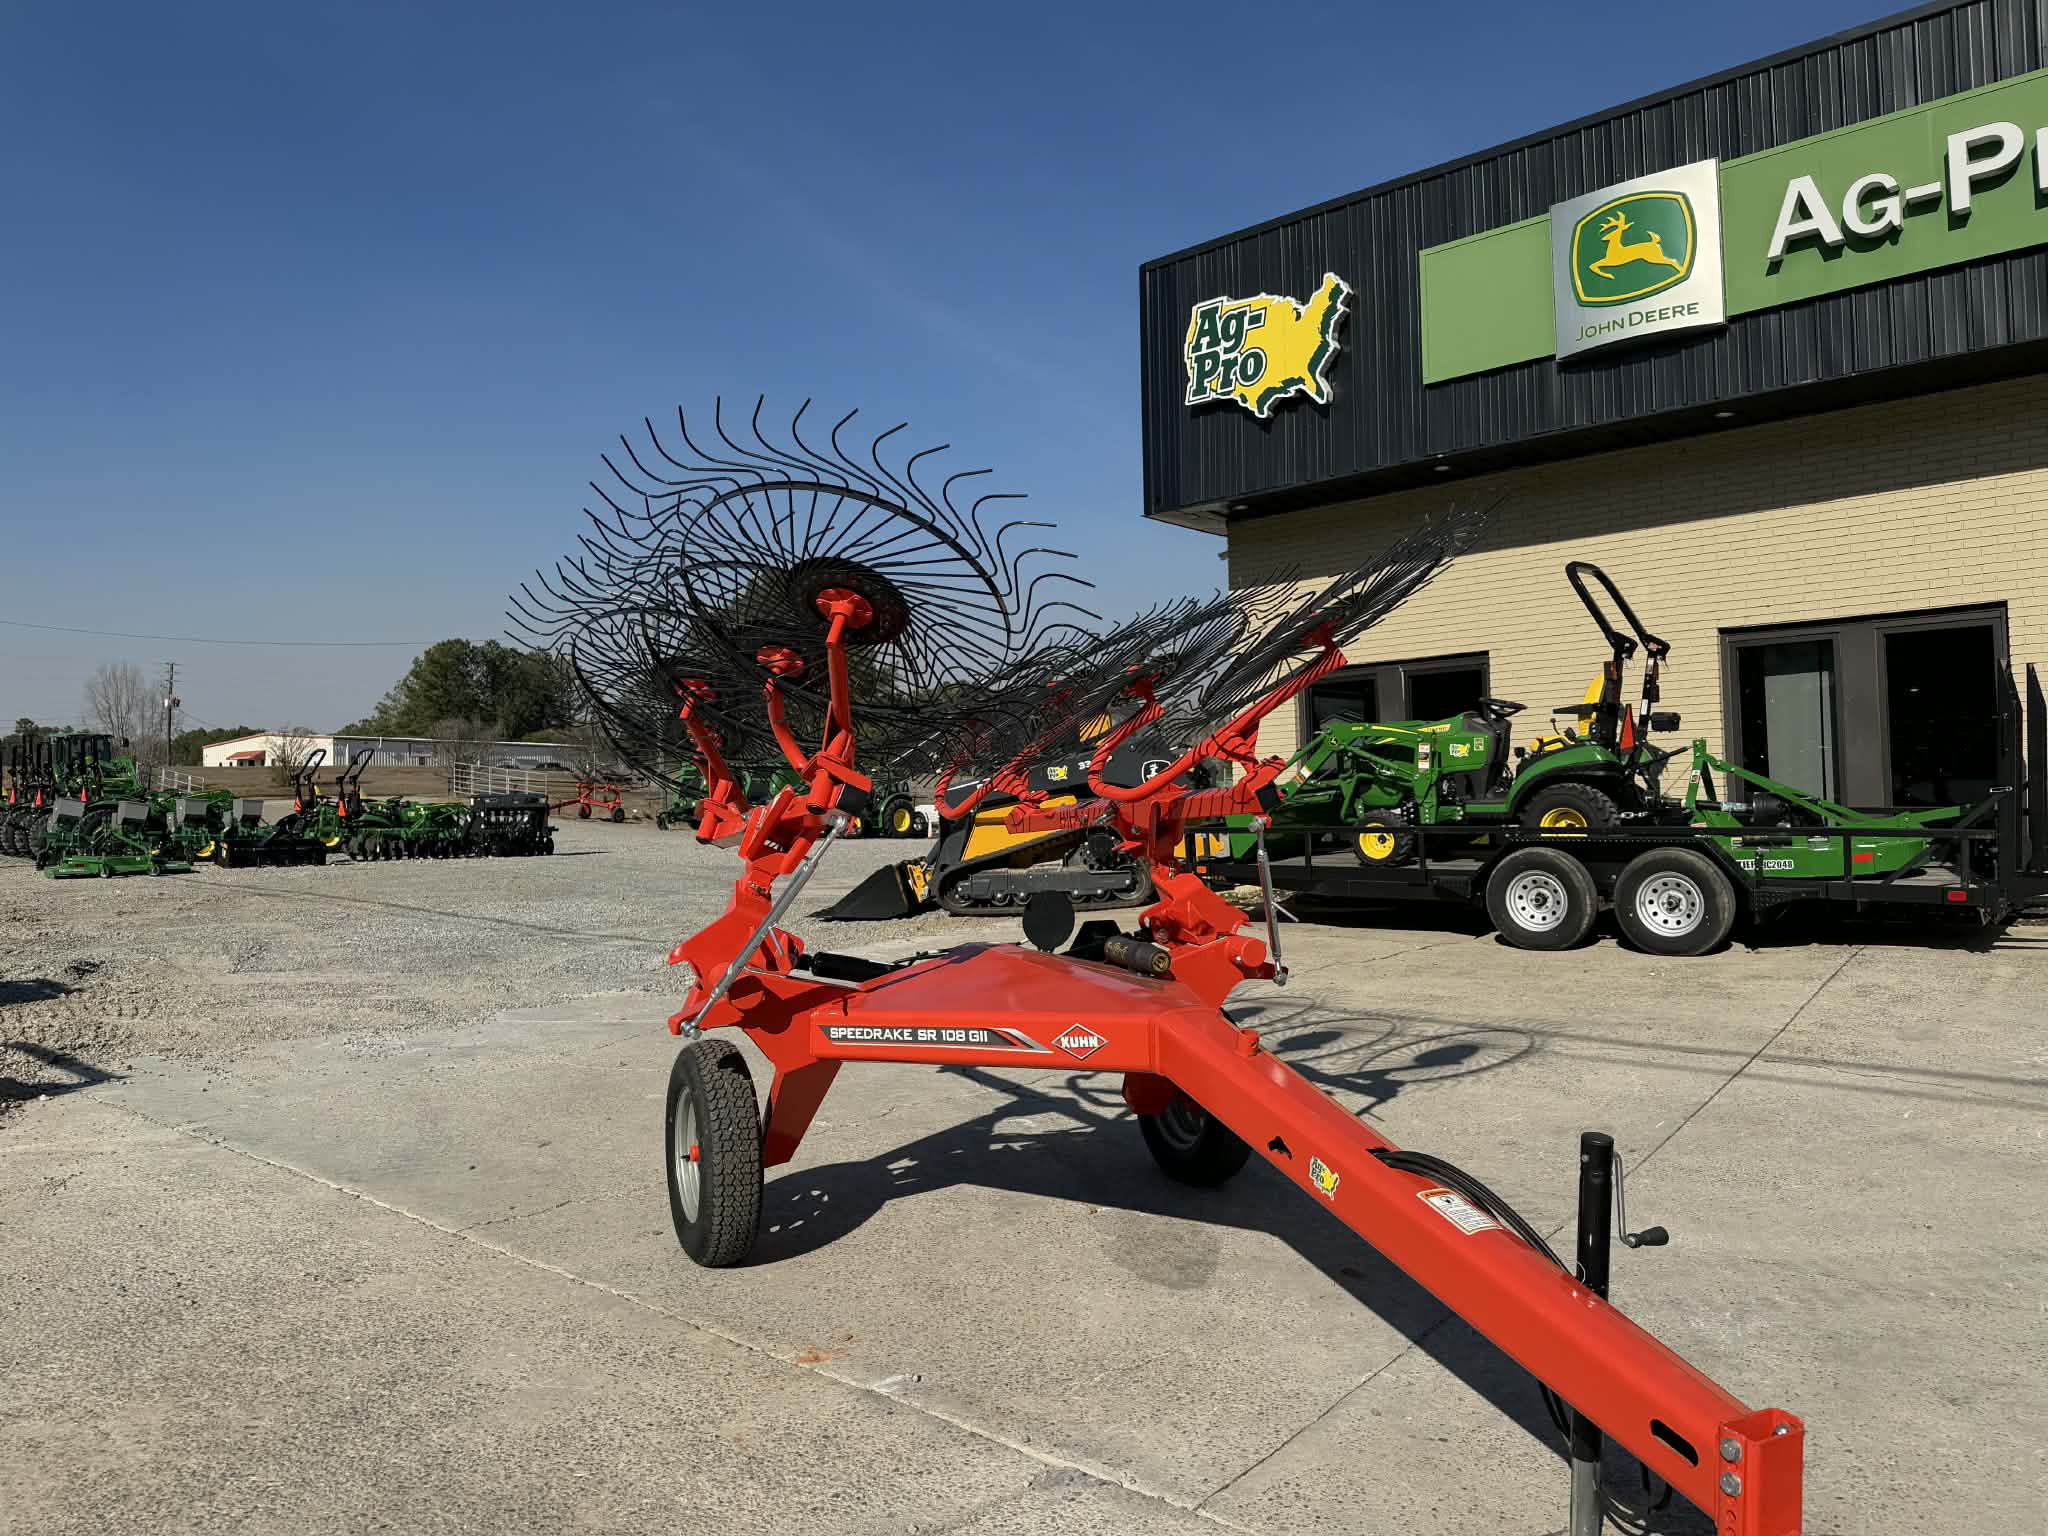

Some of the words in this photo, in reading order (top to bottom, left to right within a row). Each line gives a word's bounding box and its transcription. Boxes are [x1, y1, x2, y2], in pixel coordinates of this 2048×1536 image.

[1766, 121, 2048, 260] AG-P
[1190, 304, 1264, 356] Ag-
[1576, 317, 1625, 342] JOHN
[1628, 302, 1701, 328] DEERE
[1190, 349, 1265, 399] Pro
[830, 1027, 913, 1041] SPEEDRAKE
[917, 1031, 937, 1041] SR
[940, 1030, 966, 1042] 108
[968, 1030, 988, 1043] GII
[1060, 1035, 1100, 1049] KUHN
